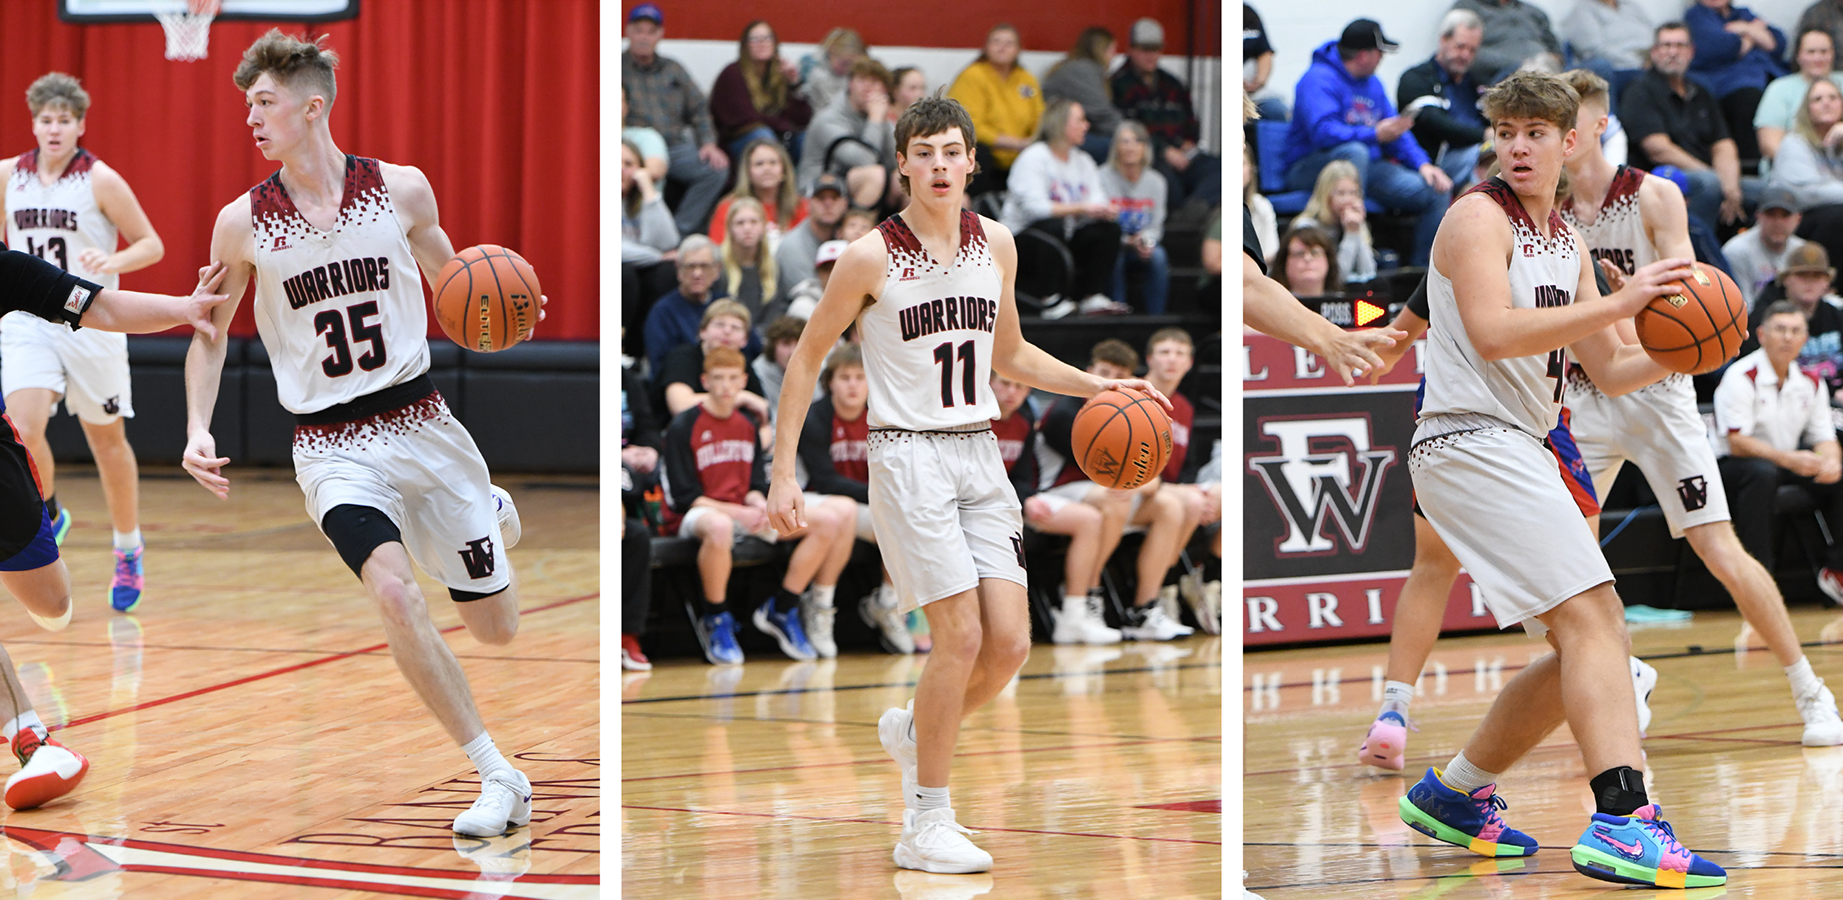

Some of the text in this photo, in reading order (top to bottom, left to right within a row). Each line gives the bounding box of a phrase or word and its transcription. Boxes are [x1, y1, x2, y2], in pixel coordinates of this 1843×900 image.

[282, 256, 390, 311] WARRIORS
[314, 300, 387, 378] 35
[898, 296, 997, 342] WARRIORS
[933, 340, 976, 408] 11
